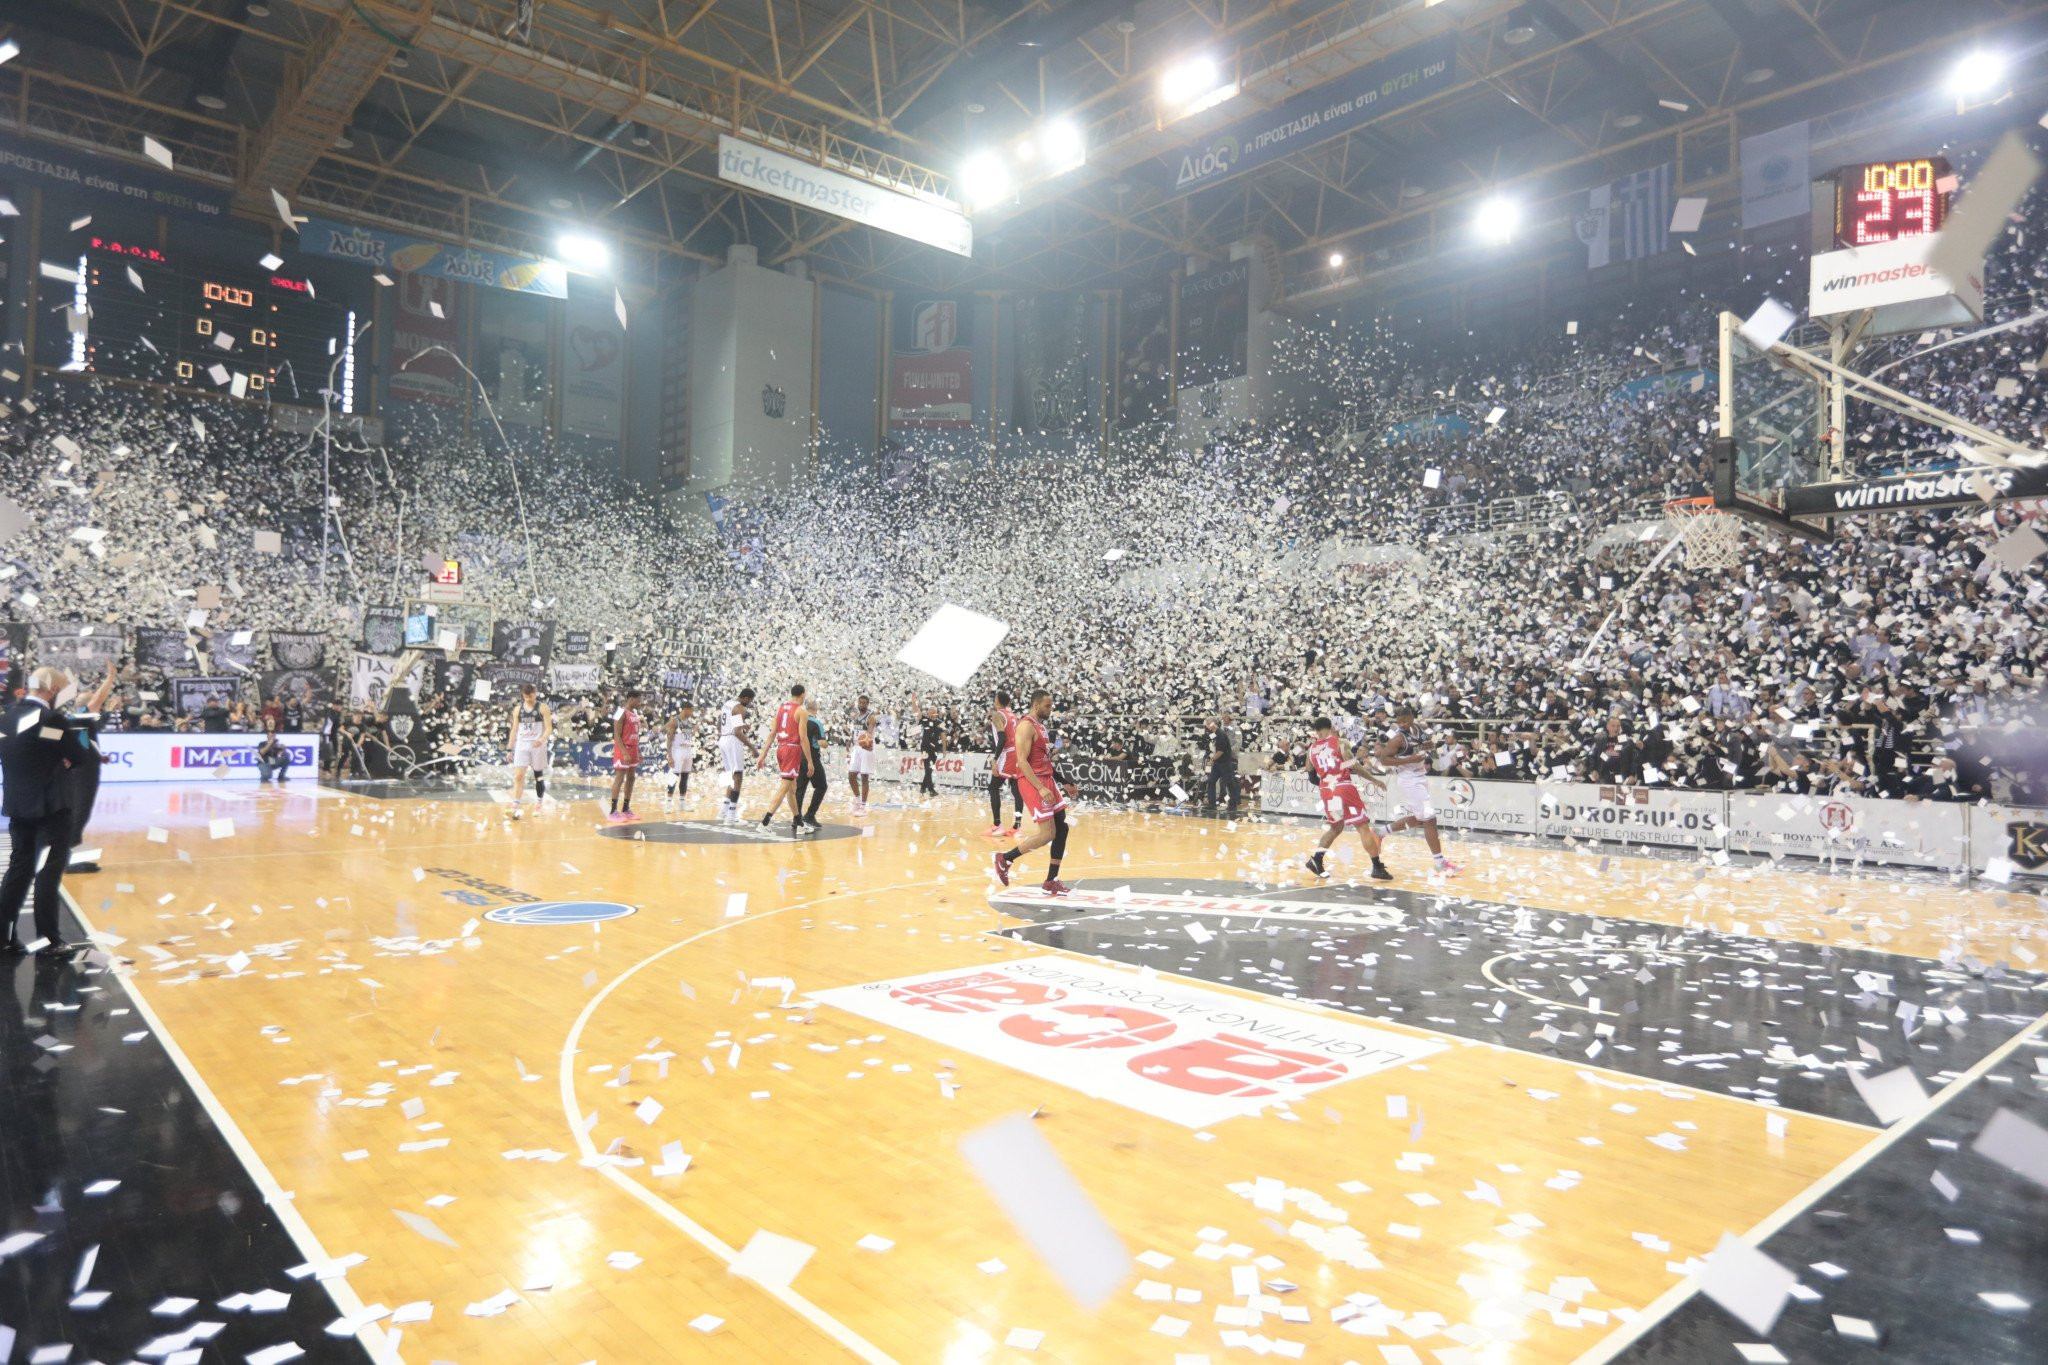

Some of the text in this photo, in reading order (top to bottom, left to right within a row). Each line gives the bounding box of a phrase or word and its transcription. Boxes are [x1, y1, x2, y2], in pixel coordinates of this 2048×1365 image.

[1176, 145, 1229, 186] Διός
[1255, 112, 1321, 150] ΠΡΟΣΤΑΣΙΑ
[1323, 100, 1353, 122] είναι
[1355, 90, 1378, 109] στη
[1380, 68, 1419, 96] ΦΥΣΗ
[1422, 60, 1446, 79] του
[722, 147, 875, 216] ticketmaster
[1863, 159, 1934, 192] 10:00
[86, 176, 120, 193] είναι
[123, 186, 149, 200] στη
[196, 202, 220, 216] του
[1857, 189, 1934, 243] 23
[331, 226, 384, 260] λουξ
[446, 250, 495, 281] λουξ
[203, 281, 253, 307] 10:00
[188, 748, 307, 765] MALTEOS
[1055, 761, 1120, 782] ARCOM
[1540, 803, 1717, 831] SIDIROPOULOS
[1545, 823, 1610, 839] FURNITURE
[1004, 964, 1404, 1065] LIGHTING APOSTOLIDIS
